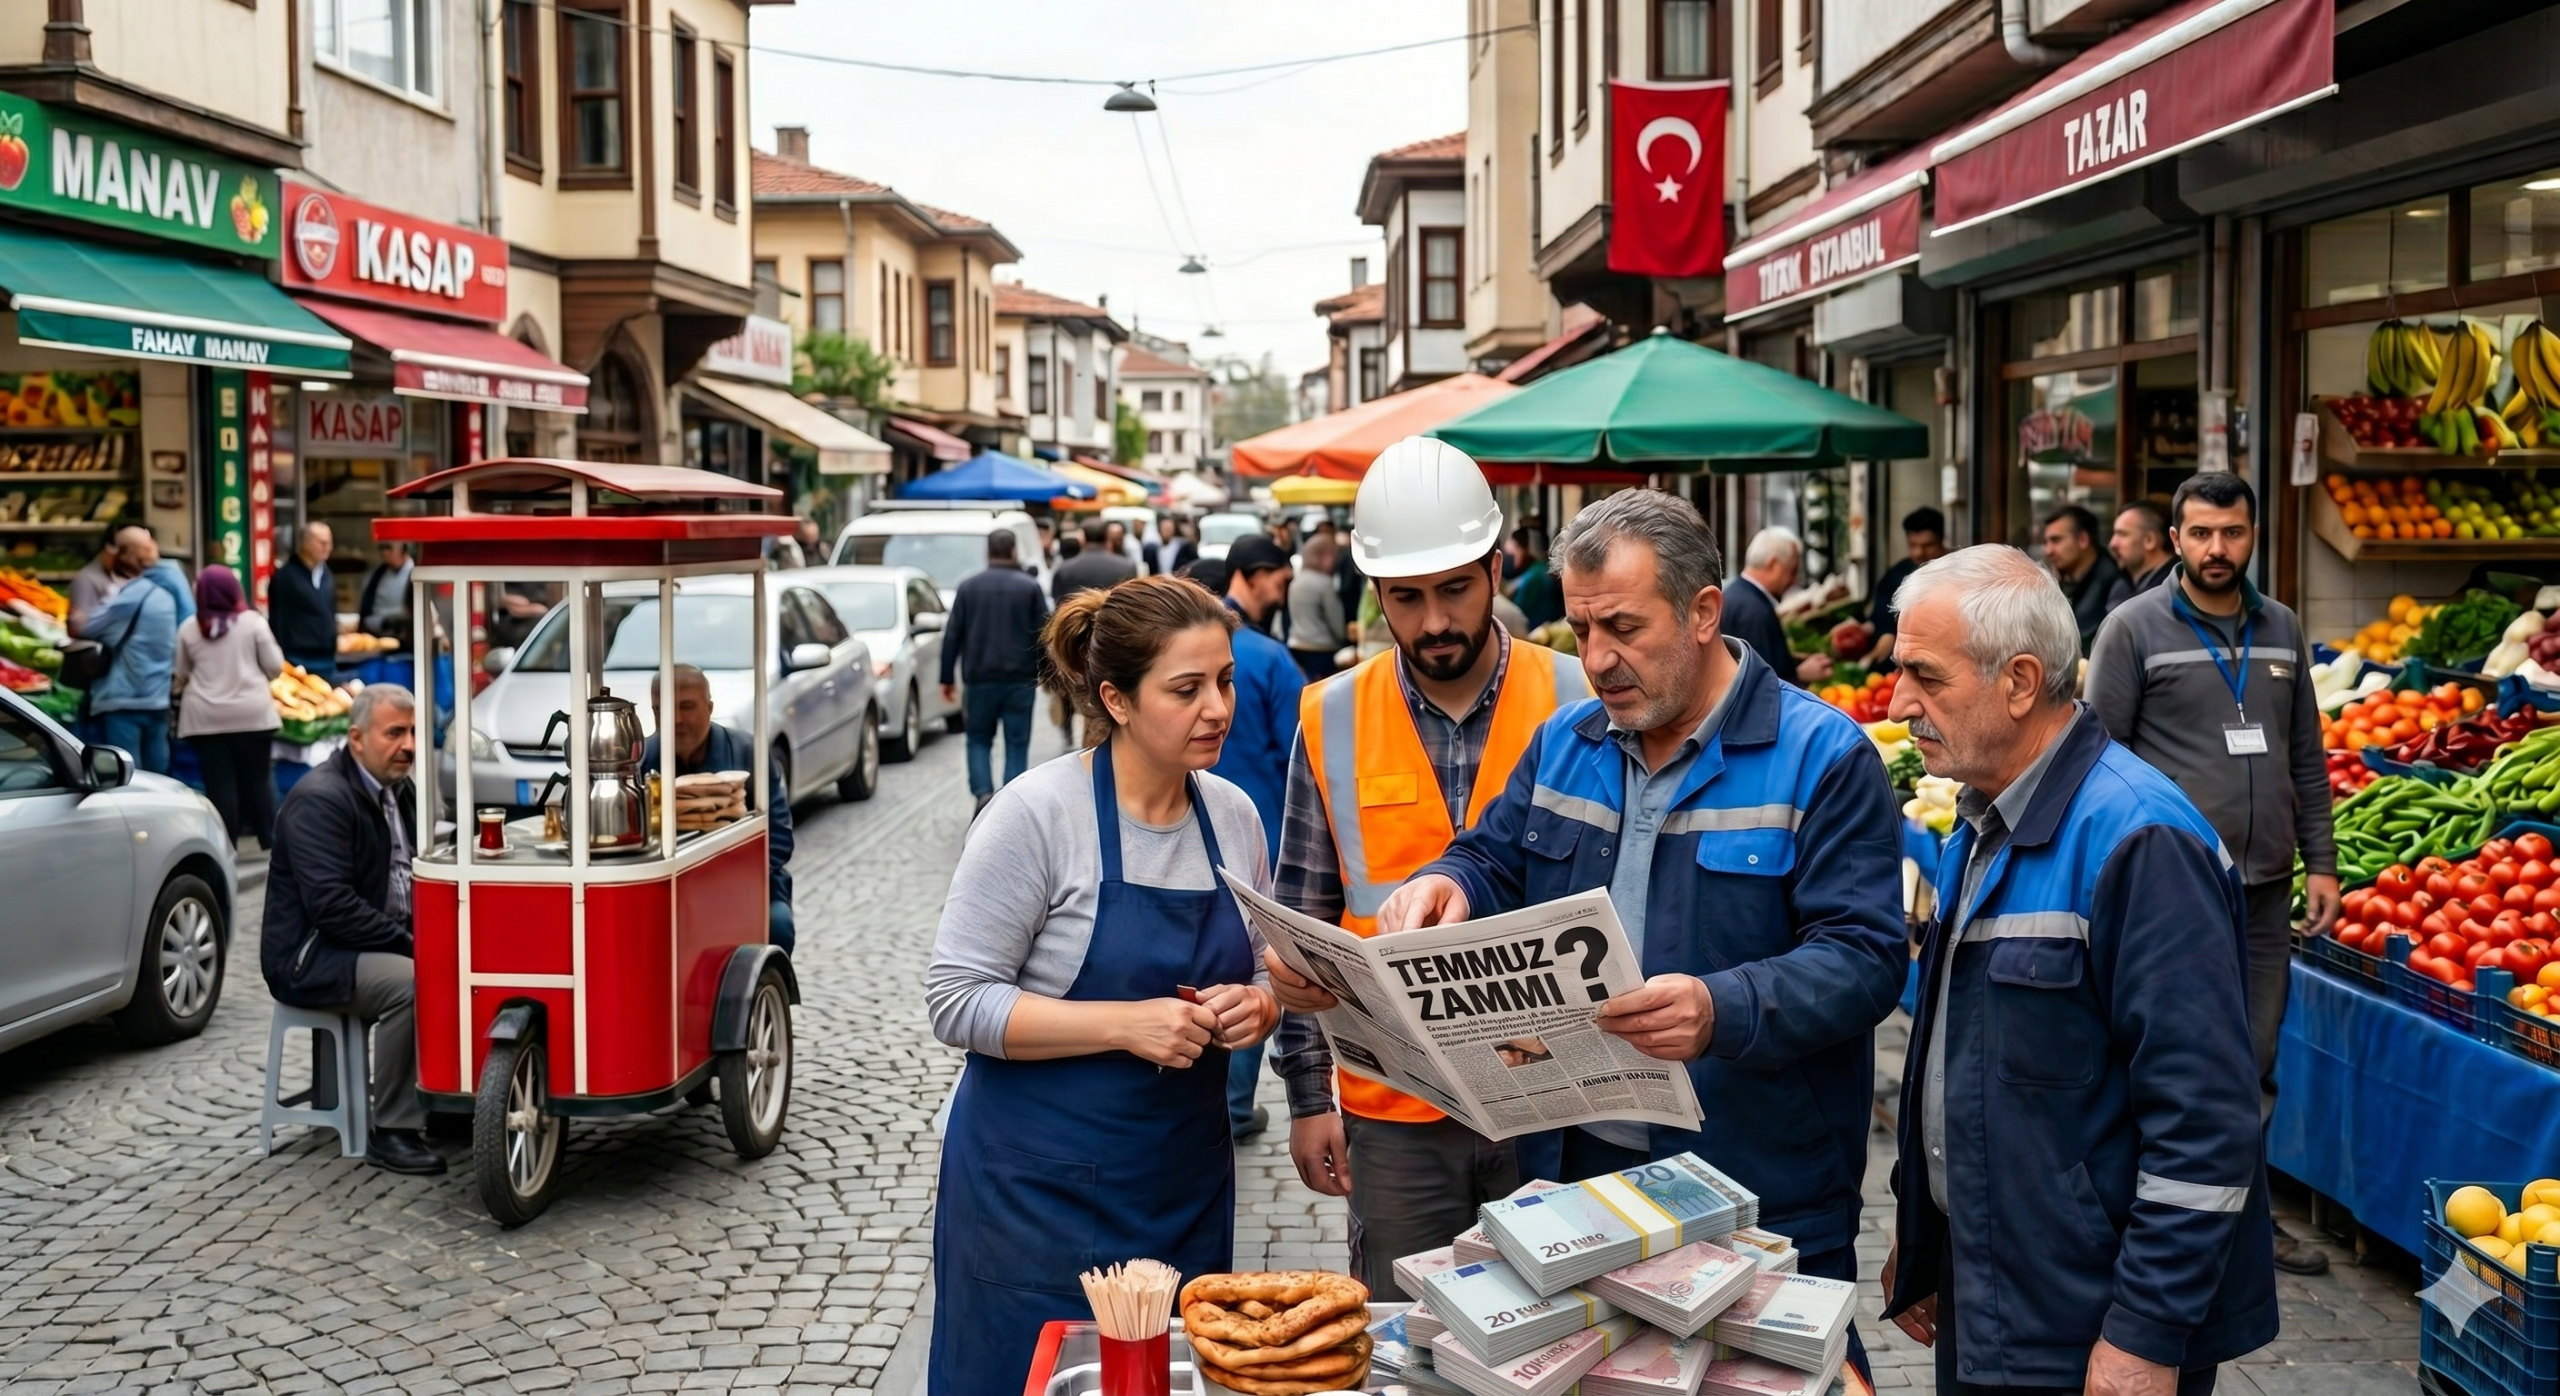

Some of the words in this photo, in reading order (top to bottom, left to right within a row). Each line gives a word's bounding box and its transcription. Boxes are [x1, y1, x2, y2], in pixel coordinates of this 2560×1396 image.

[52, 127, 220, 230] MANAV
[356, 218, 475, 299] KASAP
[309, 401, 403, 444] KASAP
[1386, 937, 1555, 988] TEMMUZ
[1407, 972, 1567, 1022] ZAMMI
[1622, 1164, 1677, 1187] 20
[1539, 1241, 1571, 1259] 20
[1570, 1232, 1605, 1247] EURO
[1484, 1310, 1517, 1329] 20
[1512, 1363, 1542, 1381] 10
